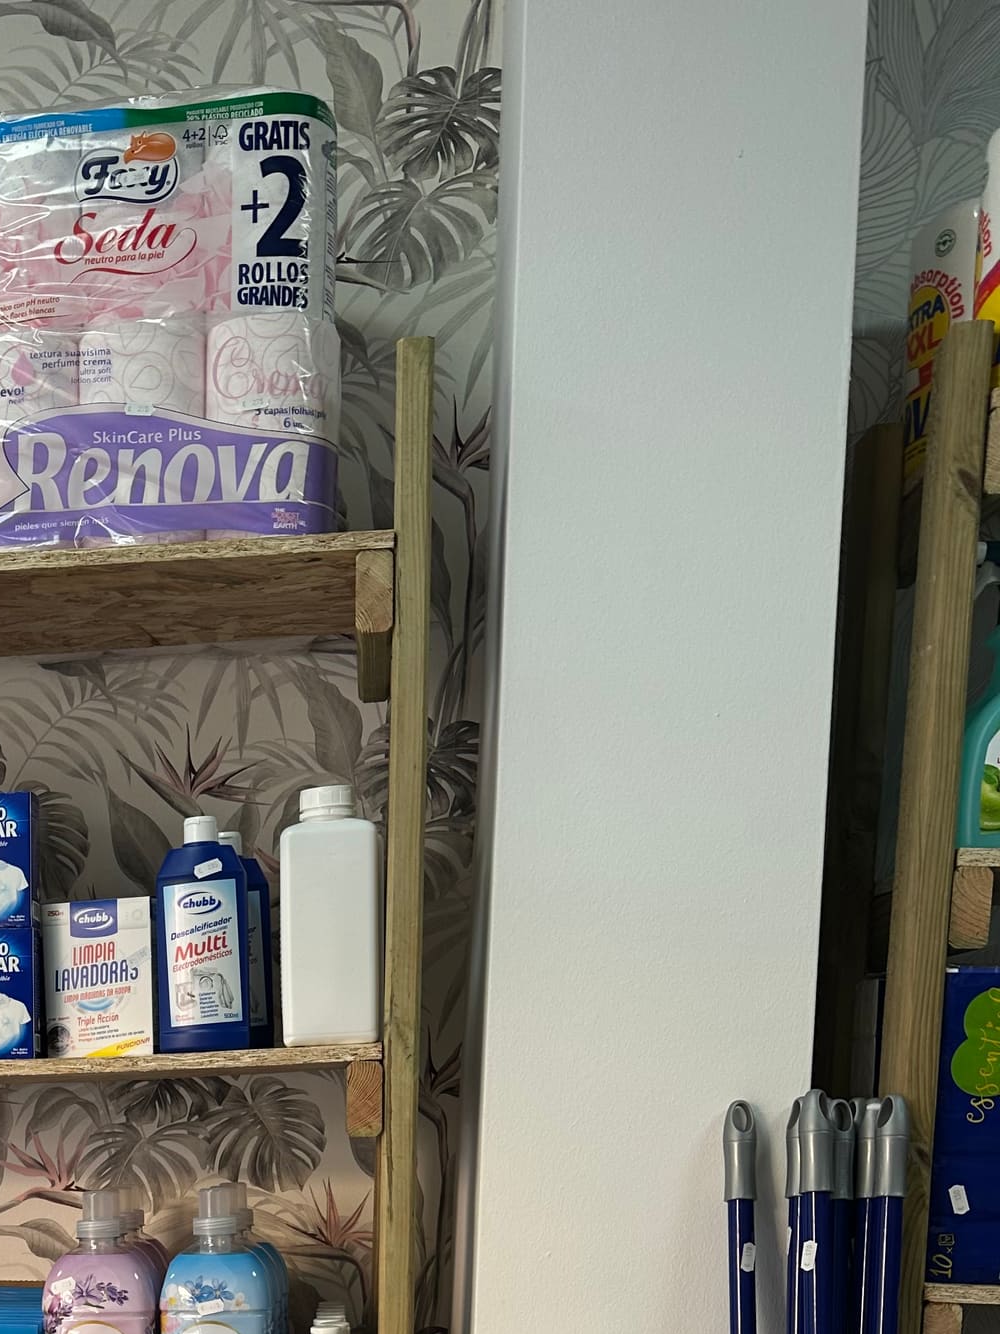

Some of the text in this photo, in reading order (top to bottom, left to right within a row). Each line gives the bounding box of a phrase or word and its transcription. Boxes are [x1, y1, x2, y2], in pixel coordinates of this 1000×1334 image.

[239, 121, 310, 151] GRATIS
[81, 157, 171, 195] Foxy
[54, 209, 176, 264] Seda
[84, 255, 112, 265] neutro
[115, 252, 135, 263] para
[148, 251, 165, 261] piel
[238, 263, 308, 285] ROLLOS
[238, 286, 308, 308] GRANDES
[42, 358, 112, 370] perfume crema
[93, 428, 201, 443] SkinCare Plus
[14, 432, 310, 511] Renova
[183, 896, 216, 908] chubb
[79, 913, 108, 923] chubb
[171, 917, 232, 941] Descalcificador
[73, 942, 115, 966] LIMPIA
[175, 932, 227, 963] Multi
[173, 949, 232, 973] Electrodomésticos
